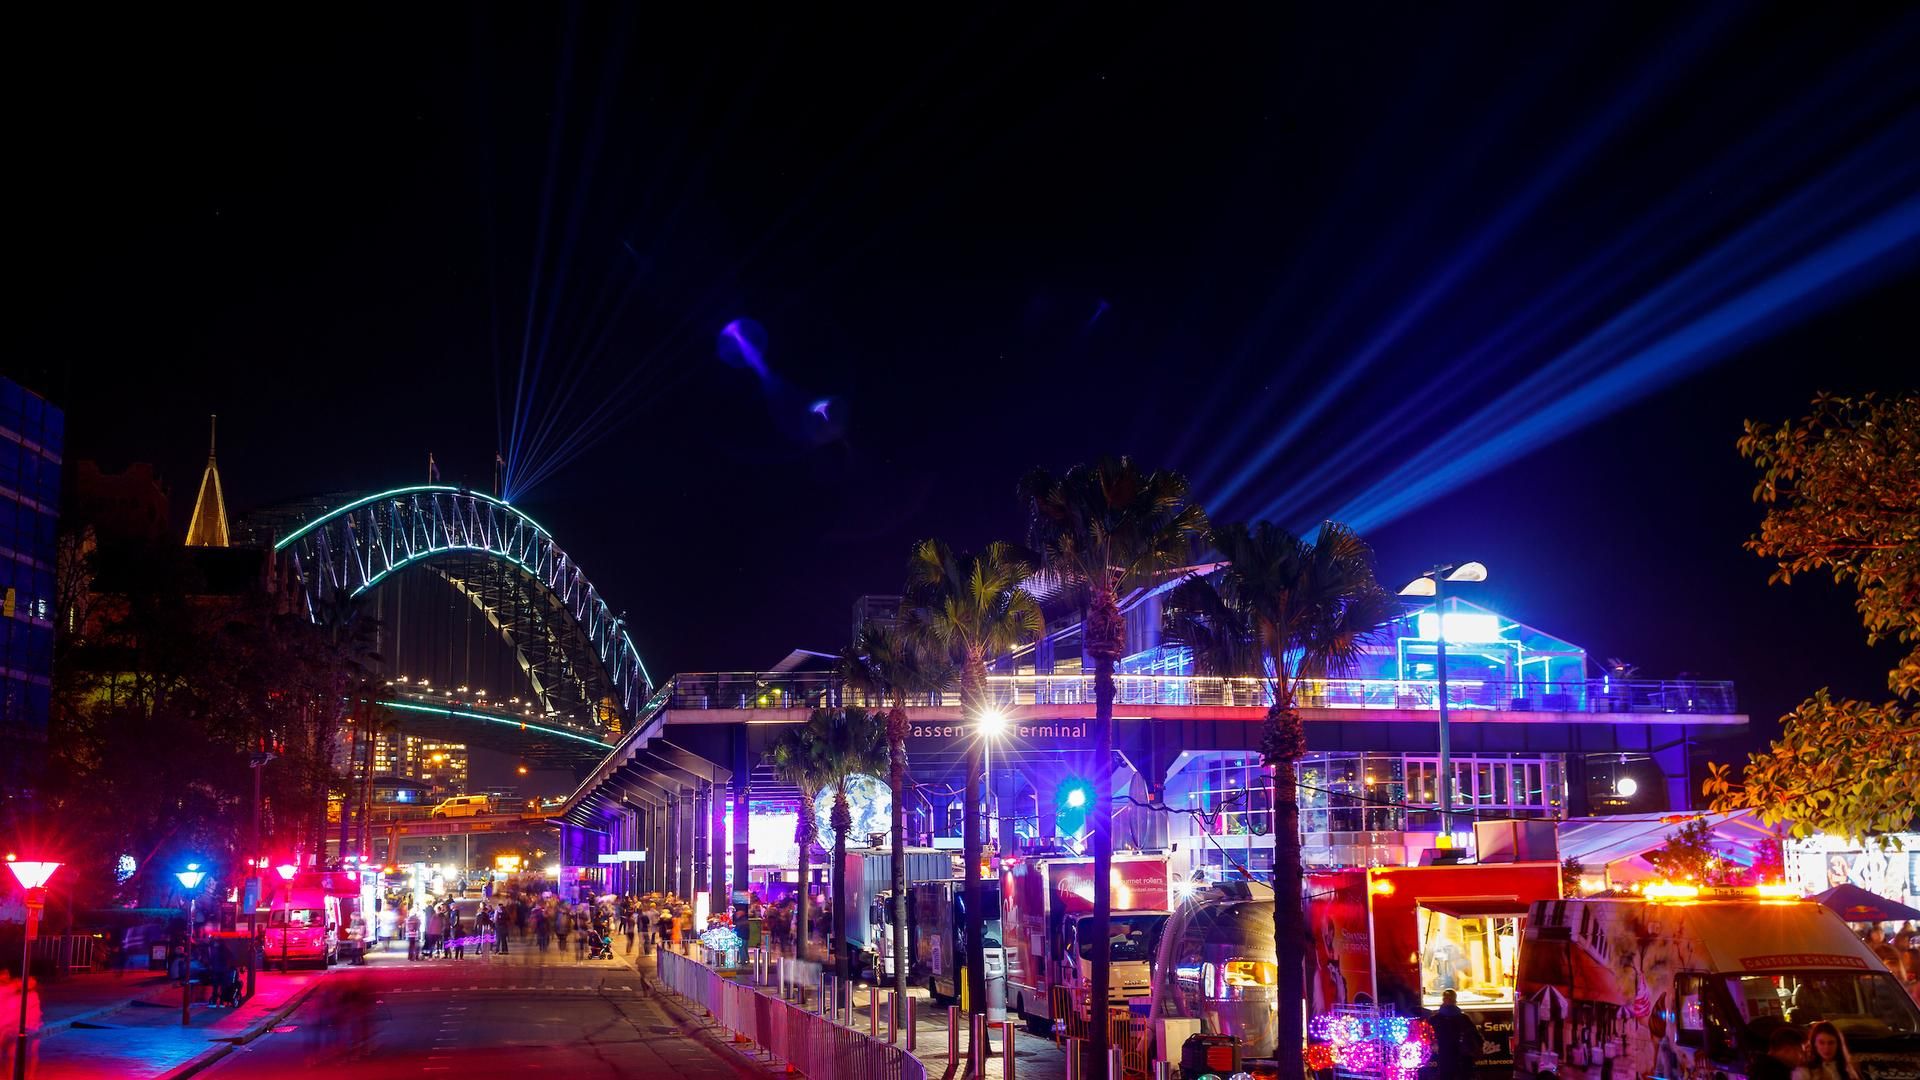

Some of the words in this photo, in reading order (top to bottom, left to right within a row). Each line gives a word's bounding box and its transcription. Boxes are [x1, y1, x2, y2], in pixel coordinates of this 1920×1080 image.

[1012, 723, 1086, 738] Terminal
[1745, 956, 1801, 968] CAUTION
[1803, 956, 1866, 969] CHILDREN
